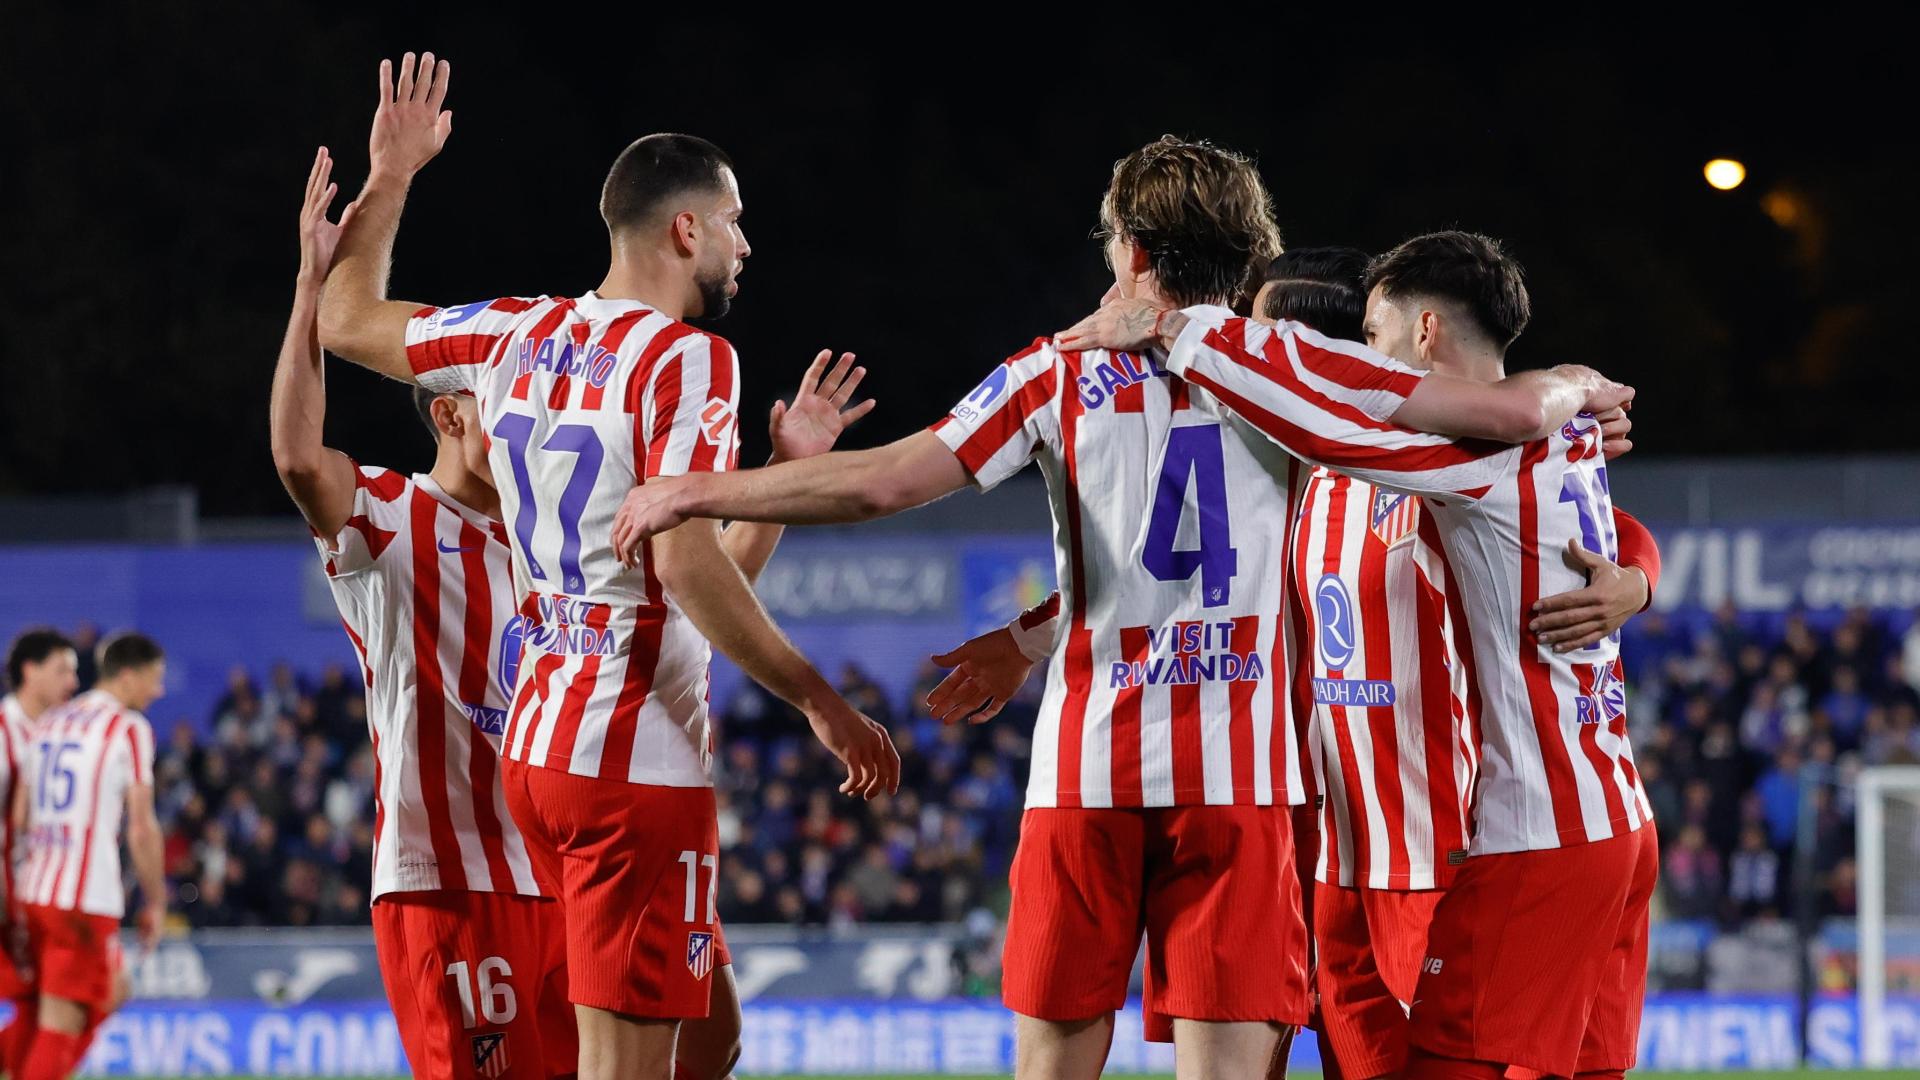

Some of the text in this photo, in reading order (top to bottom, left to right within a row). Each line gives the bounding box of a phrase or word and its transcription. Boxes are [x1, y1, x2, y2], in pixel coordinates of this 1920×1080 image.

[517, 337, 618, 388] HANCKO
[493, 411, 605, 595] 17
[1141, 423, 1238, 609] 4
[537, 595, 595, 625] VISIT
[522, 616, 616, 655] WANDA
[1145, 622, 1235, 654] VISIT
[1109, 652, 1265, 689] RWANDA
[1355, 683, 1391, 704] AIR
[38, 741, 81, 812] 15
[445, 956, 517, 1030] 16
